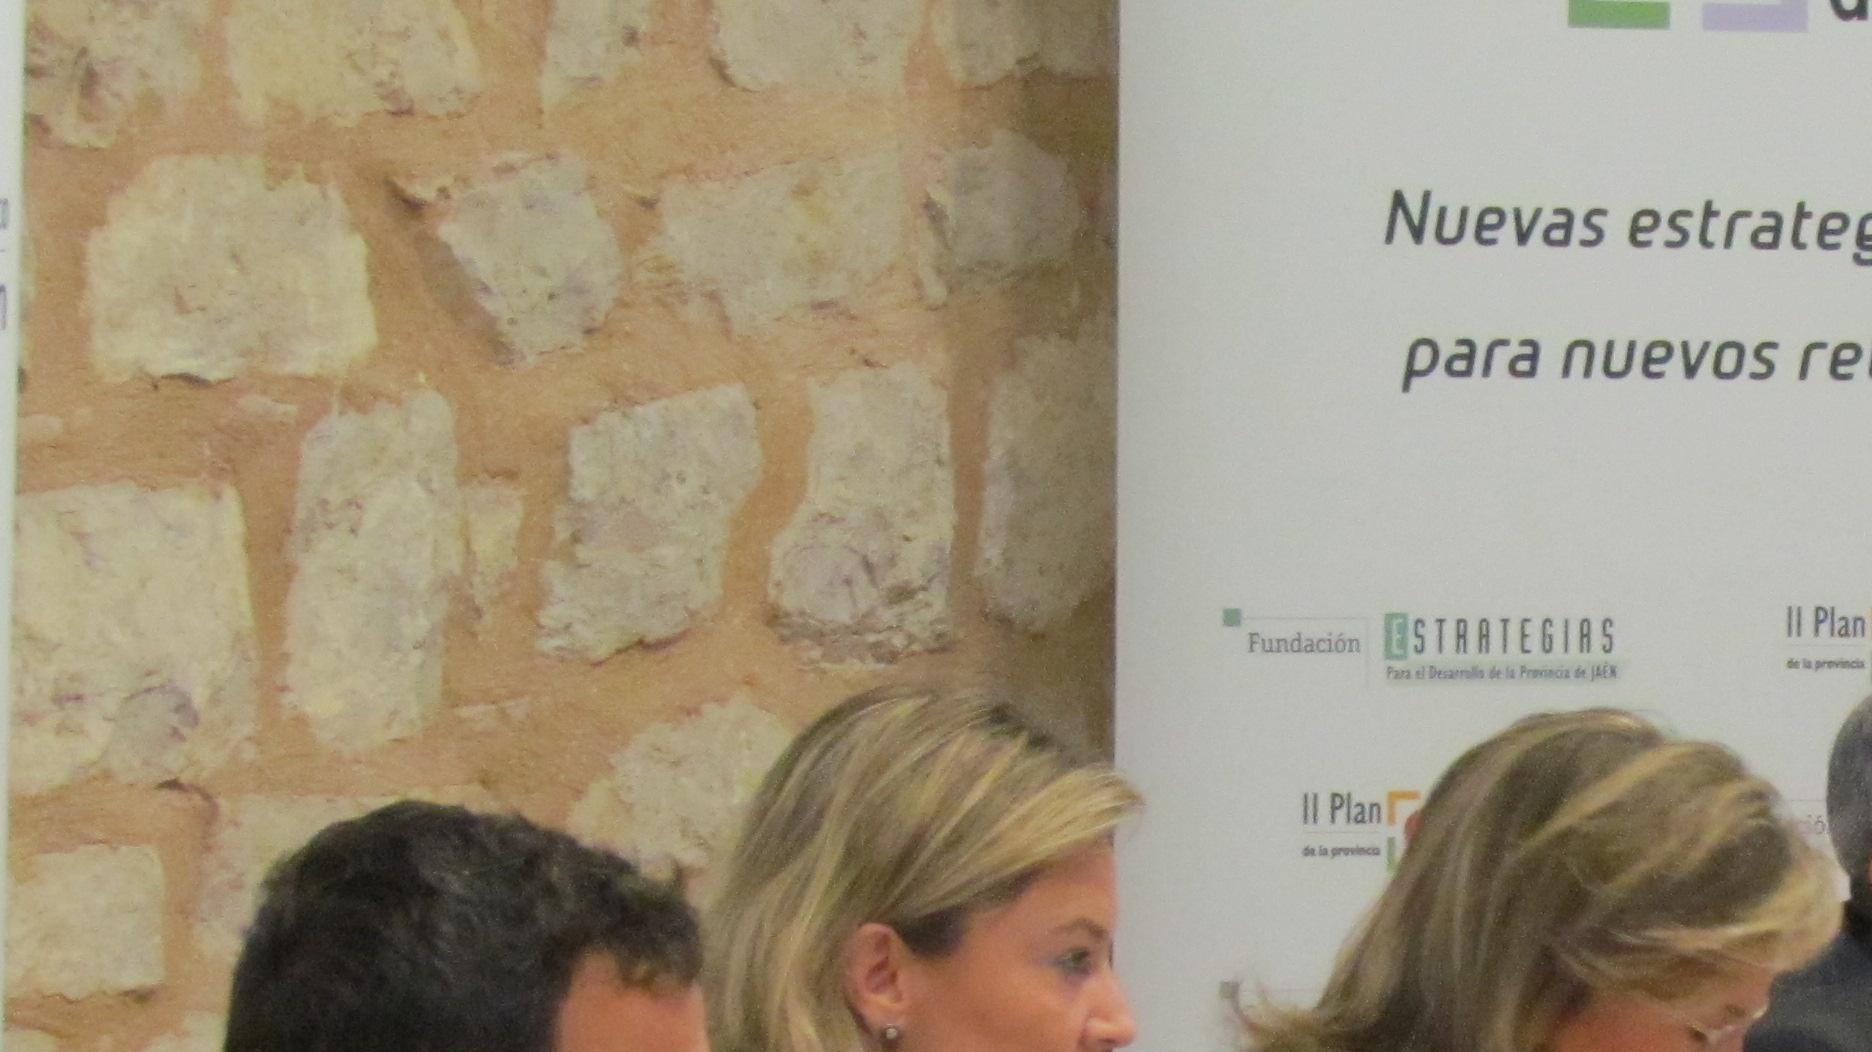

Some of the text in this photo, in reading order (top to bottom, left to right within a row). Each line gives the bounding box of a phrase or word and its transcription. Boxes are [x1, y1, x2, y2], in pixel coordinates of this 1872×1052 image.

[1384, 189, 1609, 248] Nuevas
[1402, 337, 1541, 394] para
[1561, 337, 1780, 381] nuevos
[1247, 614, 1615, 657] Fundación ESTRATEGIAS
[1786, 606, 1802, 638] II
[1813, 605, 1866, 639] Plan
[1386, 665, 1411, 680] Para
[1414, 665, 1426, 680] el
[1428, 664, 1485, 680] Desarrollo
[1488, 665, 1501, 680] de
[1504, 665, 1516, 680] la
[1519, 664, 1571, 680] Provincia
[1573, 665, 1587, 680] de
[1786, 658, 1866, 672] de la provincia
[1302, 791, 1382, 825] II Plan
[1302, 845, 1382, 860] de la provincia
